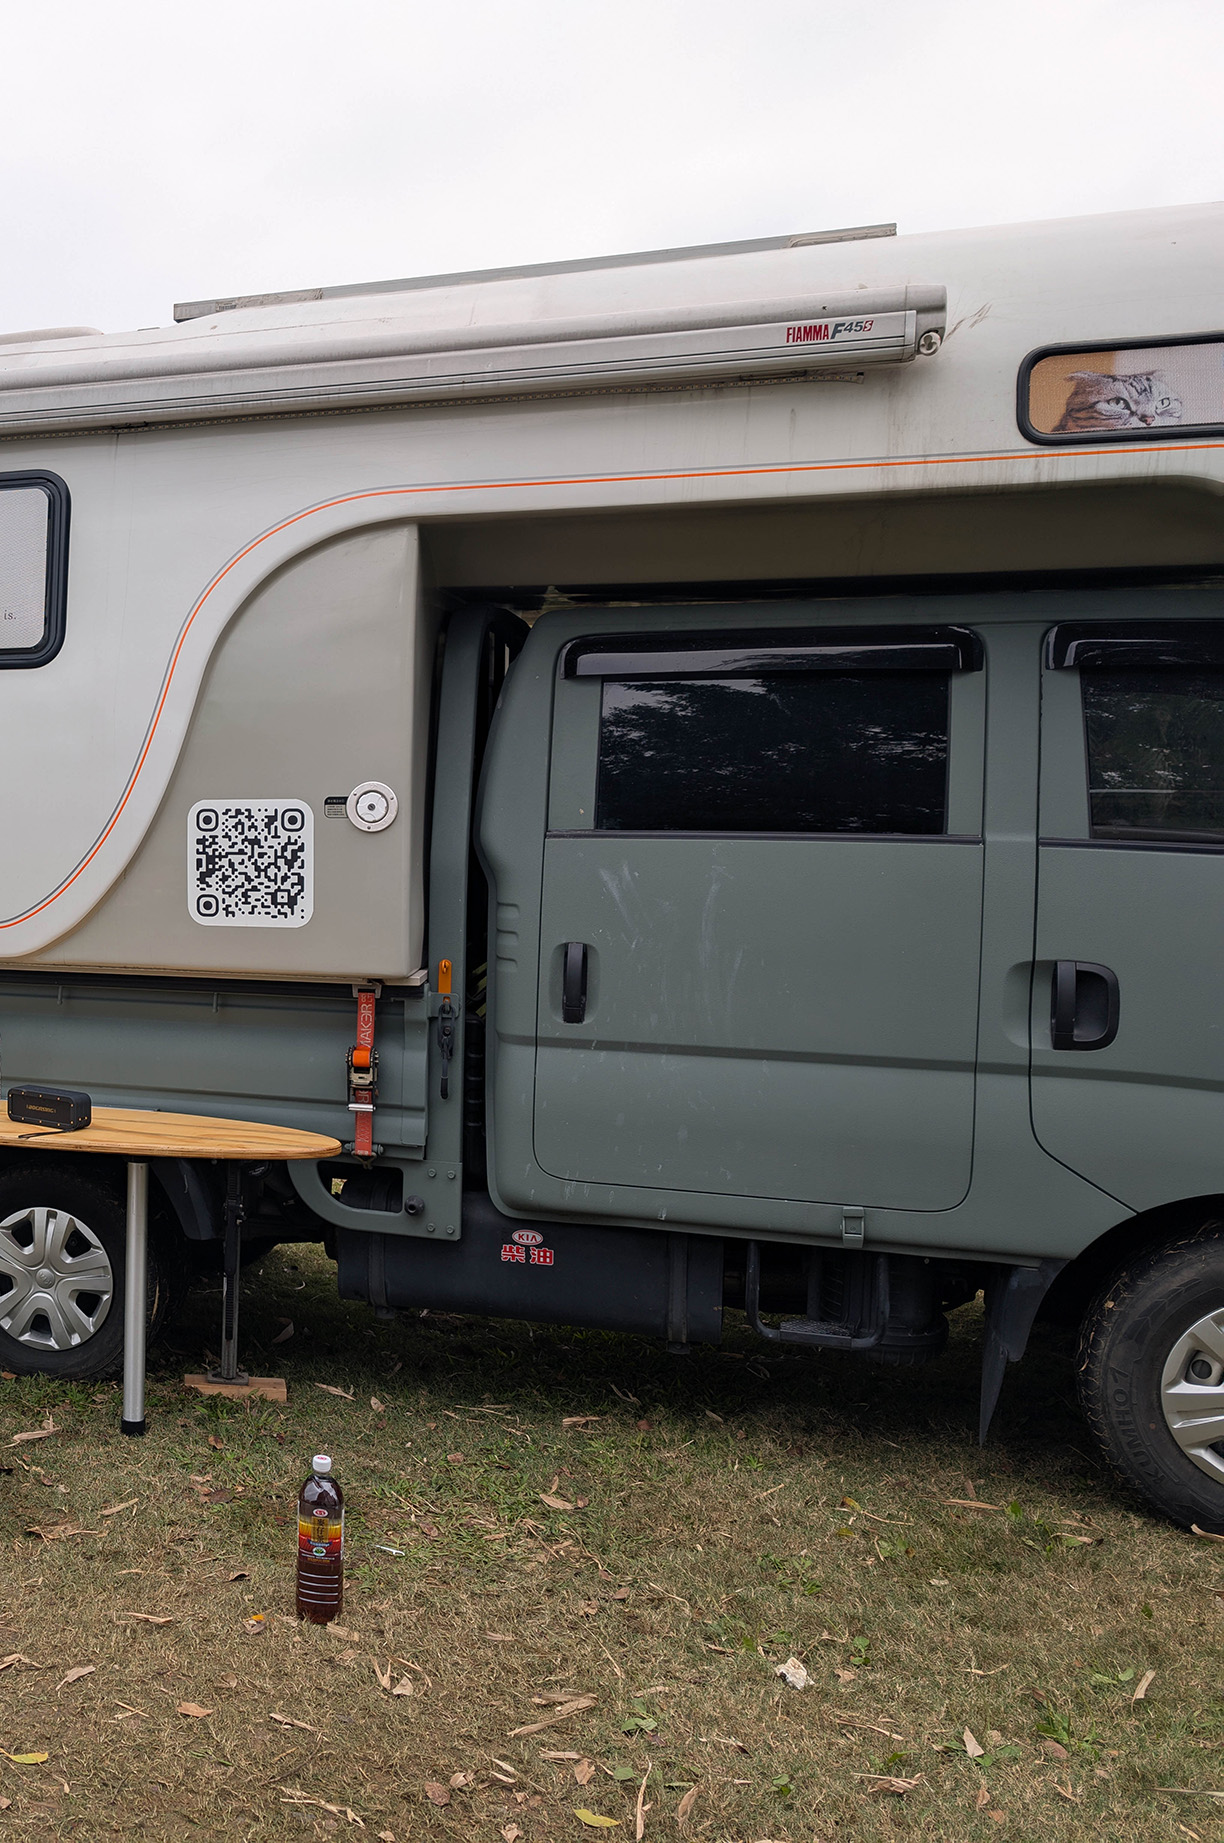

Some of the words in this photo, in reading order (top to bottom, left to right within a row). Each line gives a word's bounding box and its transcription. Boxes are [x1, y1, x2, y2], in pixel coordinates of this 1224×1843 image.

[786, 324, 829, 343] FIAMMA
[4, 610, 17, 621] is.
[518, 1233, 539, 1244] KIA
[501, 1244, 554, 1266] 柴油
